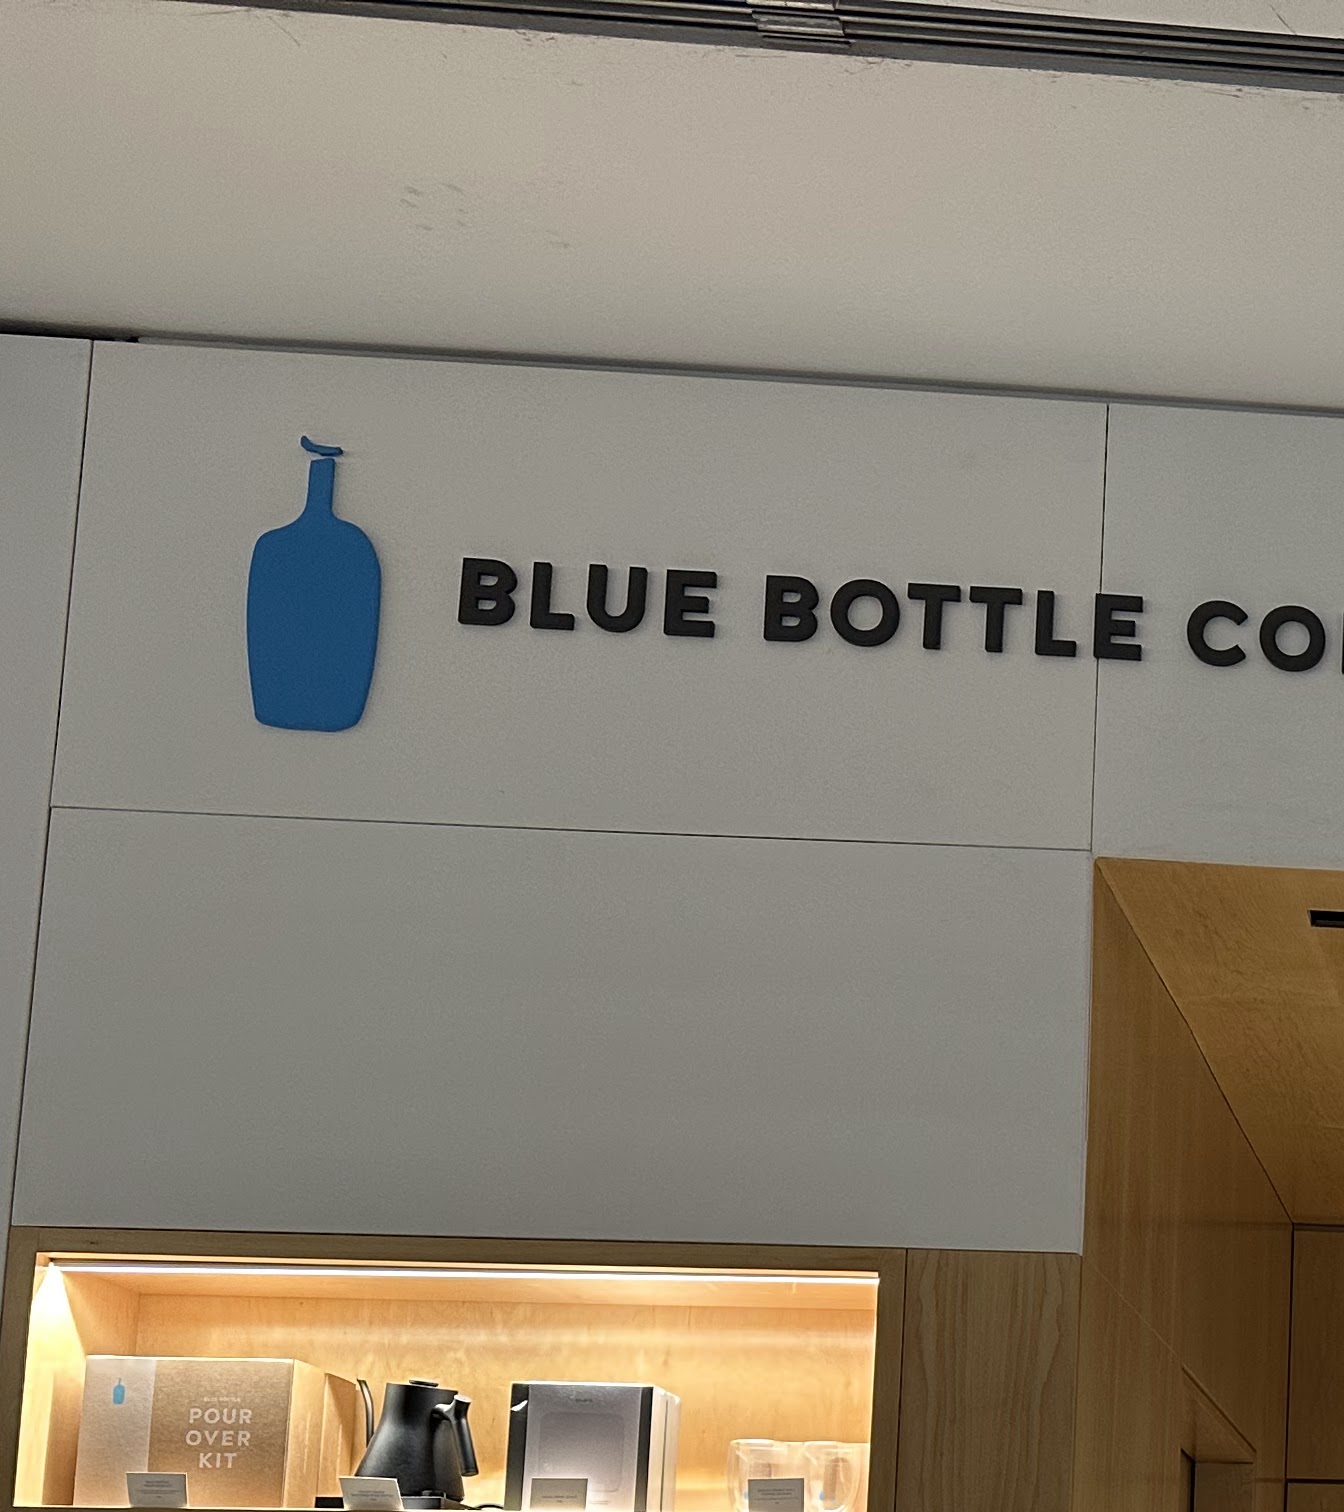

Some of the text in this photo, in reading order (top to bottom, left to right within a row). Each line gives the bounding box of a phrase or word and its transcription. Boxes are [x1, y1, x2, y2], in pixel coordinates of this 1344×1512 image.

[457, 557, 718, 639] BLUE
[764, 575, 1143, 661] BOTTLE
[189, 1408, 252, 1424] POUR
[186, 1430, 250, 1446] OVER
[199, 1453, 236, 1468] KIT
